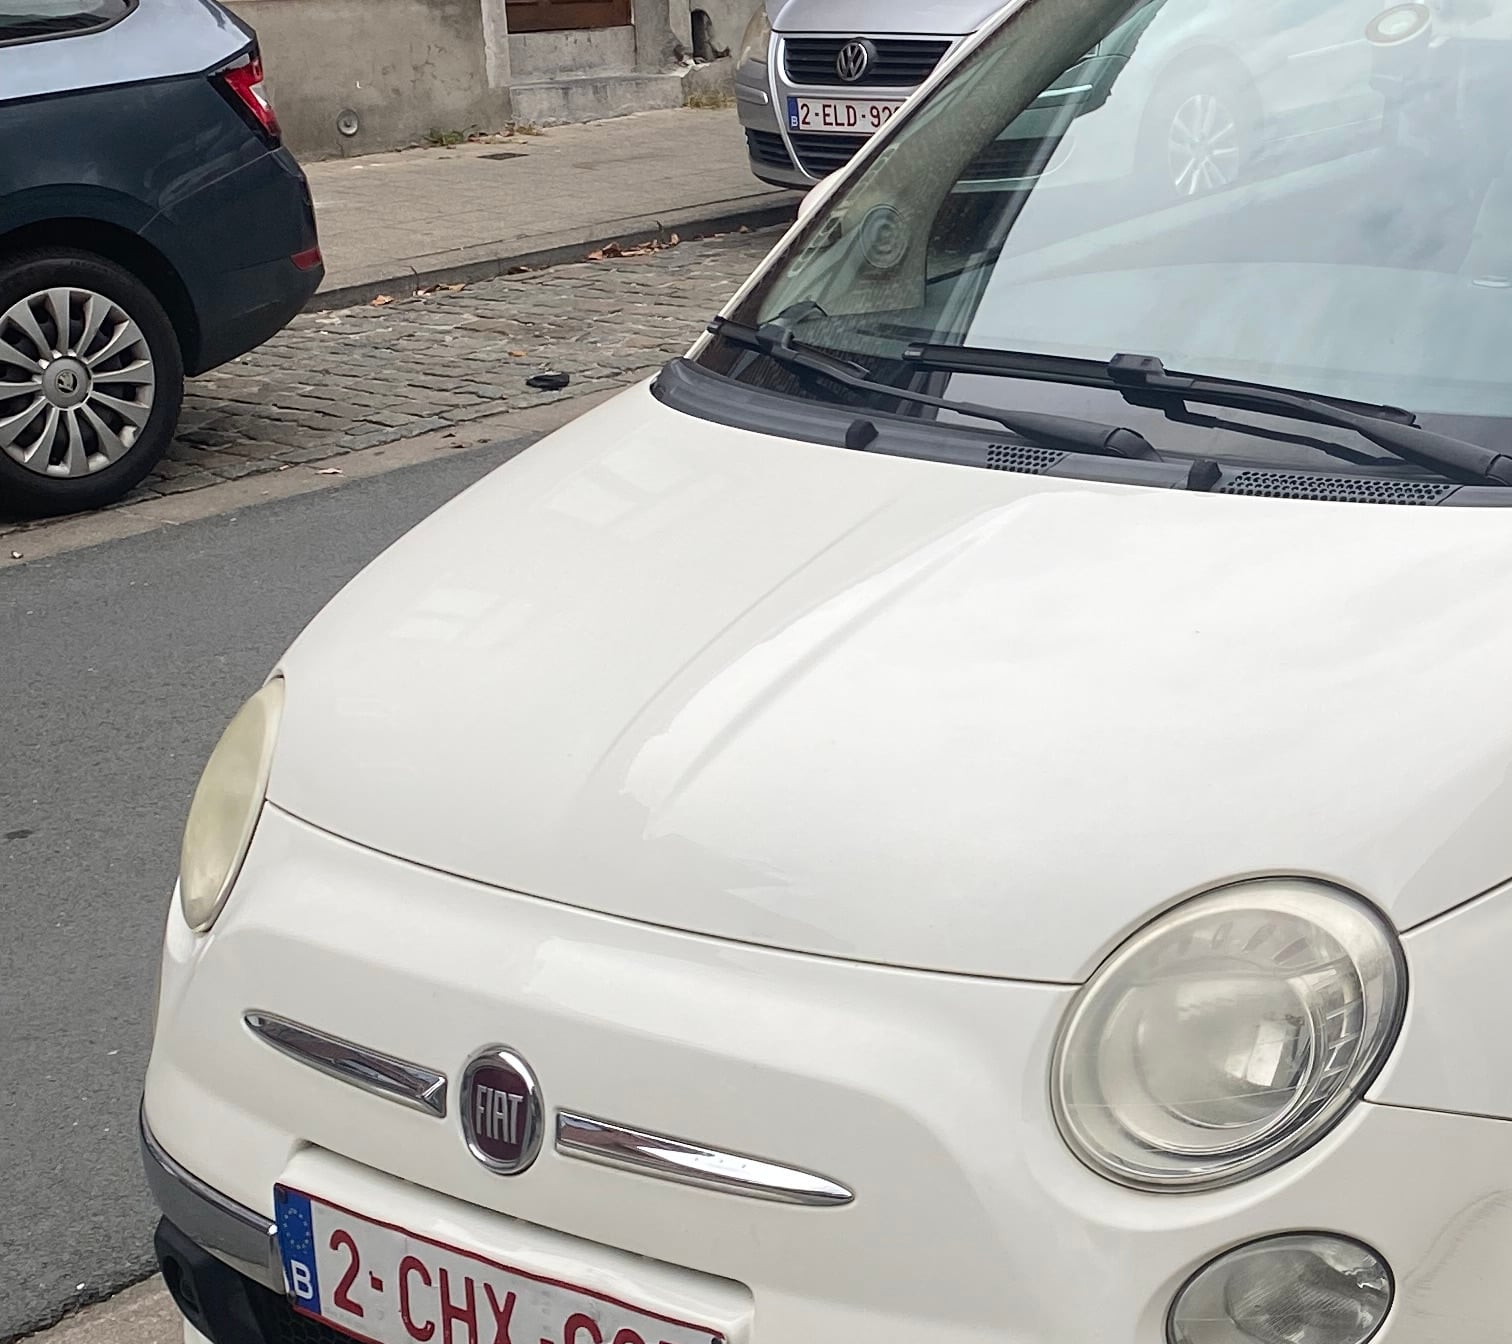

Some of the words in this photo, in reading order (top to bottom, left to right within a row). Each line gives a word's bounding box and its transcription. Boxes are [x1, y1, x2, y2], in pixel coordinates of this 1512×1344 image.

[791, 116, 798, 126] B
[800, 103, 899, 128] 2-ELD-92
[476, 1084, 524, 1145] FIAT
[290, 1259, 314, 1301] B
